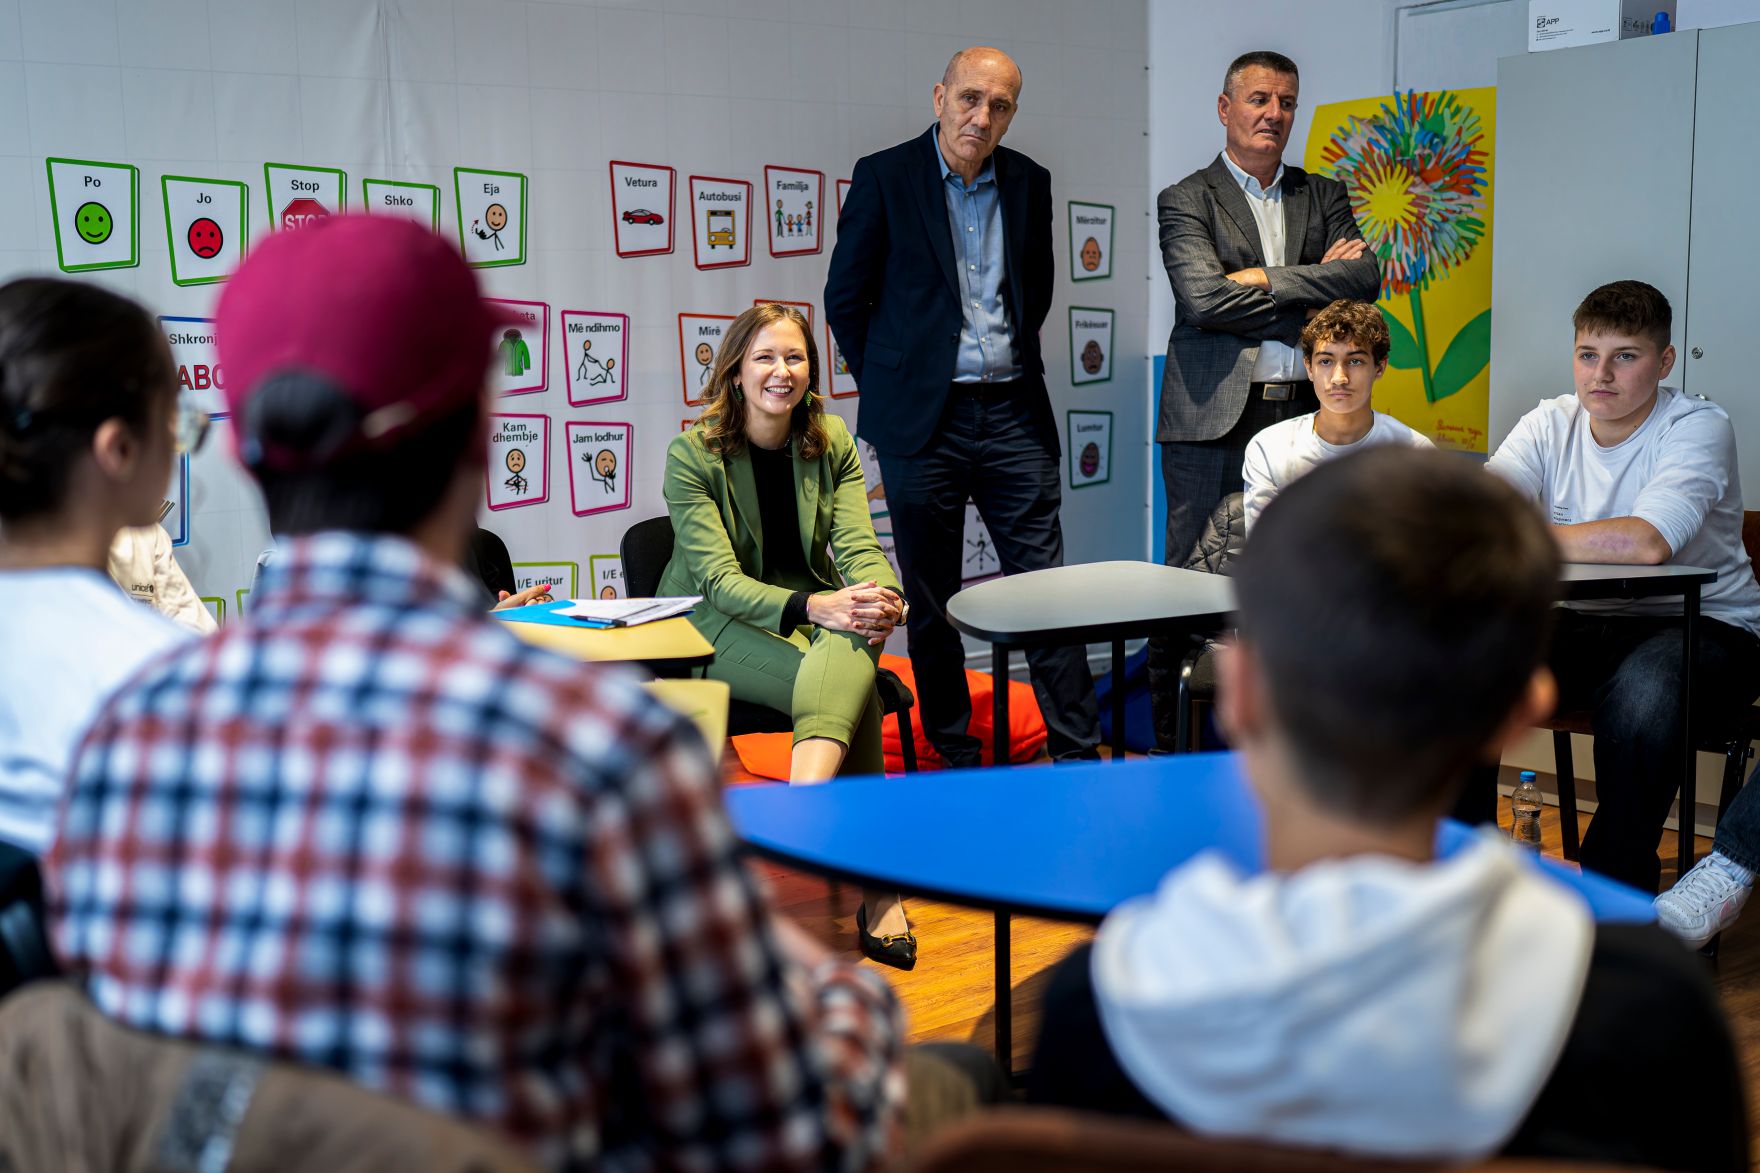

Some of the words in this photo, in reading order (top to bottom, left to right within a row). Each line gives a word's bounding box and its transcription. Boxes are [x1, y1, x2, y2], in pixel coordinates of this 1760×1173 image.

[84, 175, 101, 188] Po
[290, 179, 320, 193] Stop
[625, 176, 658, 188] Vetura
[776, 180, 809, 193] Familja
[483, 183, 500, 196] Eja
[196, 192, 212, 204] Jo
[384, 194, 414, 206] Shko
[698, 191, 742, 202] Autobusi
[568, 322, 584, 333] Më
[585, 322, 621, 333] ndihmo
[698, 326, 721, 336] Mirë
[168, 333, 218, 347] Shkronj
[503, 422, 527, 432] Kam
[492, 431, 539, 444] dhembje
[572, 434, 593, 443] Jam
[594, 431, 624, 442] lodhur
[602, 569, 617, 580] I/E
[517, 578, 533, 589] I/E
